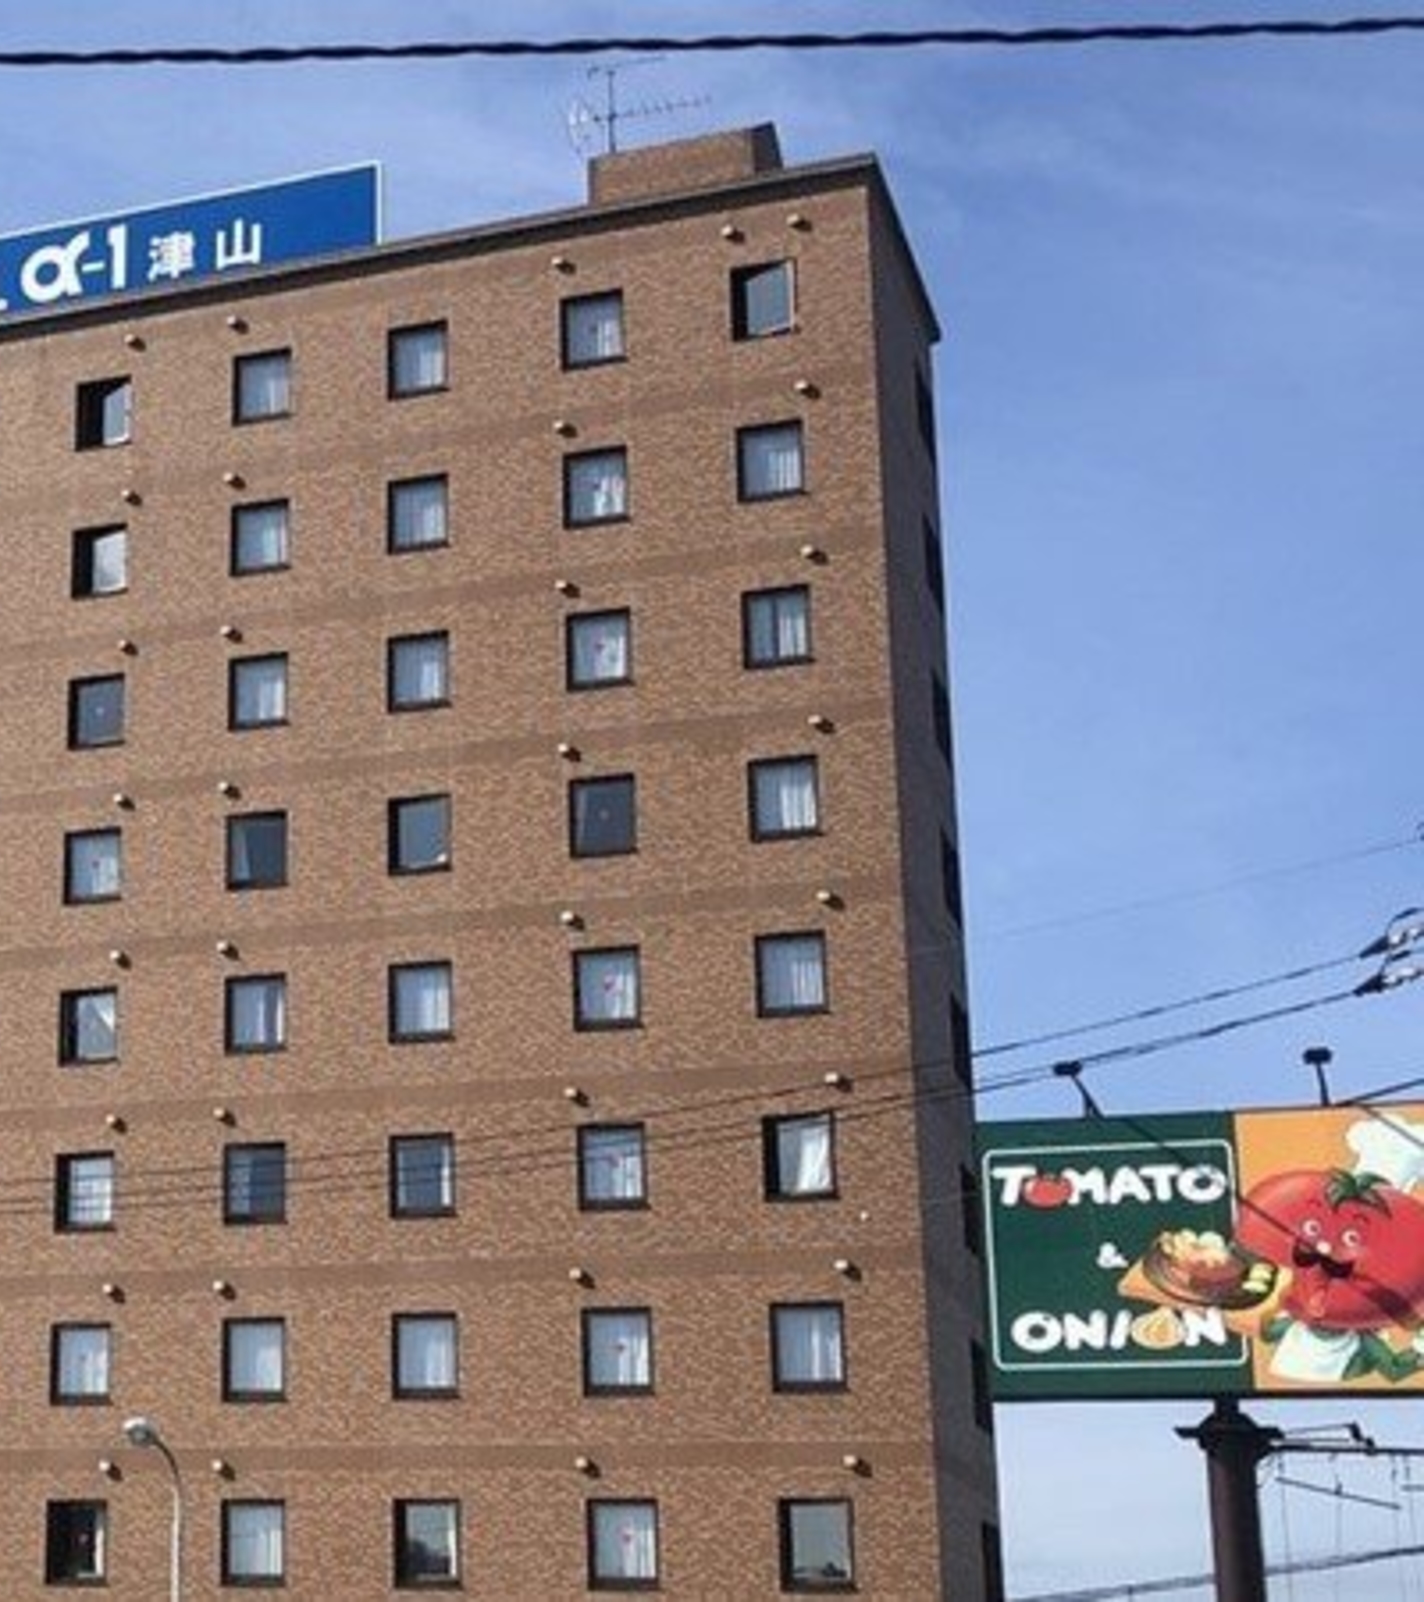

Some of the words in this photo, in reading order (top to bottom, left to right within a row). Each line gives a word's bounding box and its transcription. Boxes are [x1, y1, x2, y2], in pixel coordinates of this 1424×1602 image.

[147, 218, 262, 282] 津山
[991, 1163, 1228, 1209] TOMATO
[1096, 1242, 1128, 1269] &
[1010, 1307, 1228, 1353] ONION
